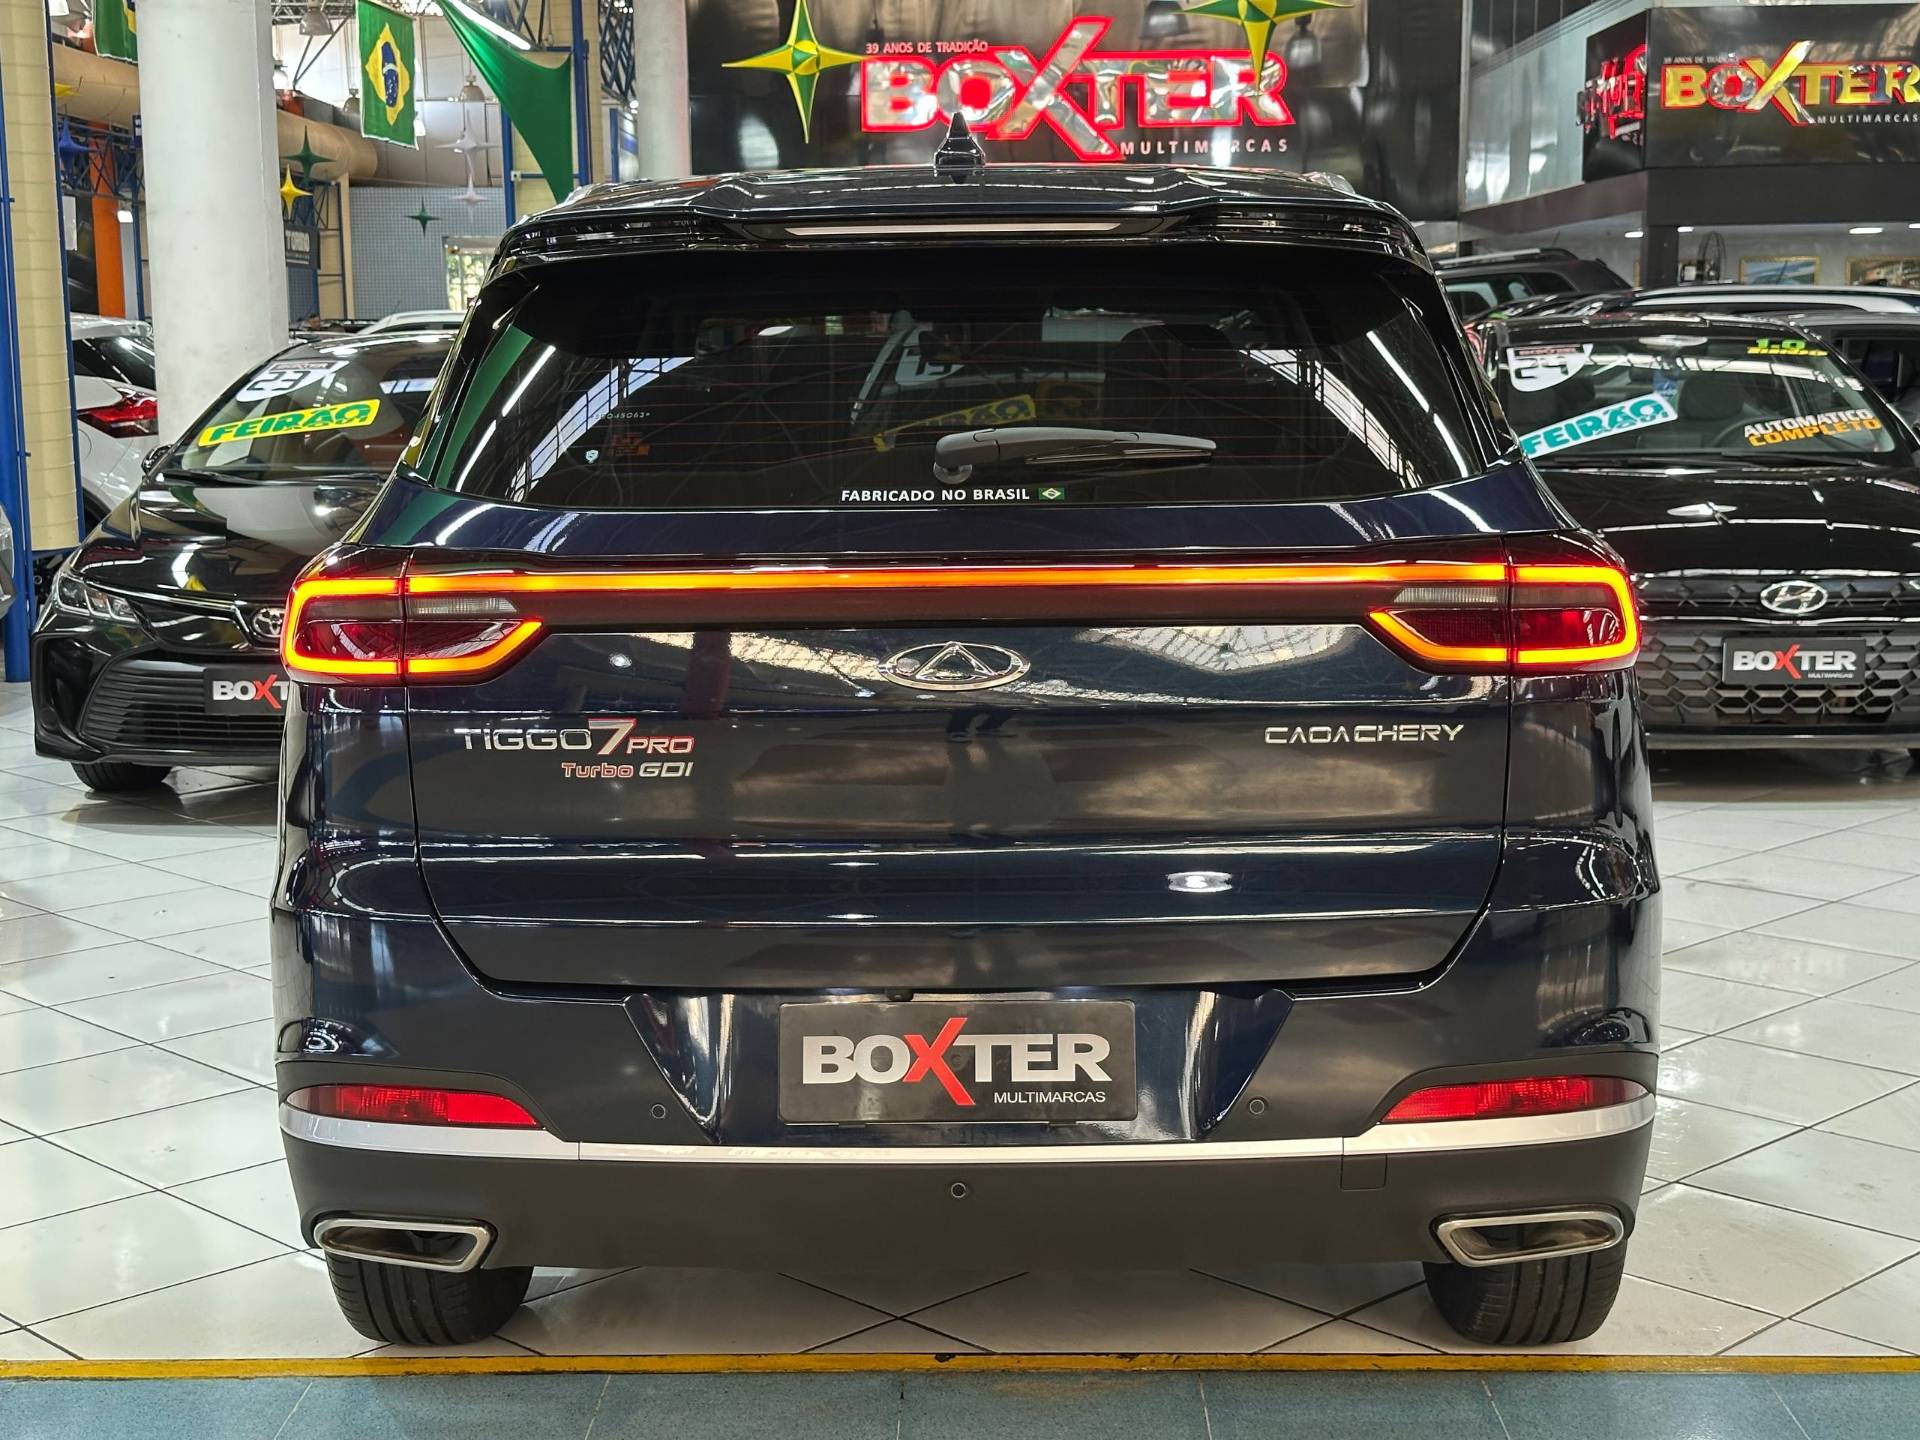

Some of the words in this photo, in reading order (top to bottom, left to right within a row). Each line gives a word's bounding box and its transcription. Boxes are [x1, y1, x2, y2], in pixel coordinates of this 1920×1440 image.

[866, 43, 879, 54] 39
[883, 42, 913, 54] ANOS
[917, 42, 932, 53] DE
[936, 39, 988, 53] TRADIÇÃO
[861, 16, 1296, 161] BOXTER
[1661, 39, 1920, 126] BOXTER
[1817, 113, 1919, 124] MULTIMARCAS
[1120, 138, 1288, 155] MULTIMRCAS
[209, 403, 369, 441] FEIRÃO
[1520, 399, 1666, 455] FEIRÃO
[1748, 417, 1881, 447] COMPLETO
[841, 489, 935, 501] FABRICADO
[942, 489, 966, 501] NO
[973, 488, 1030, 500] BRASIL
[1733, 644, 1856, 680] BOXTER
[561, 762, 634, 778] Turbo
[638, 761, 694, 778] GDI
[802, 1017, 1113, 1106] BOXTER
[993, 1091, 1106, 1104] MULTIMARCAS
